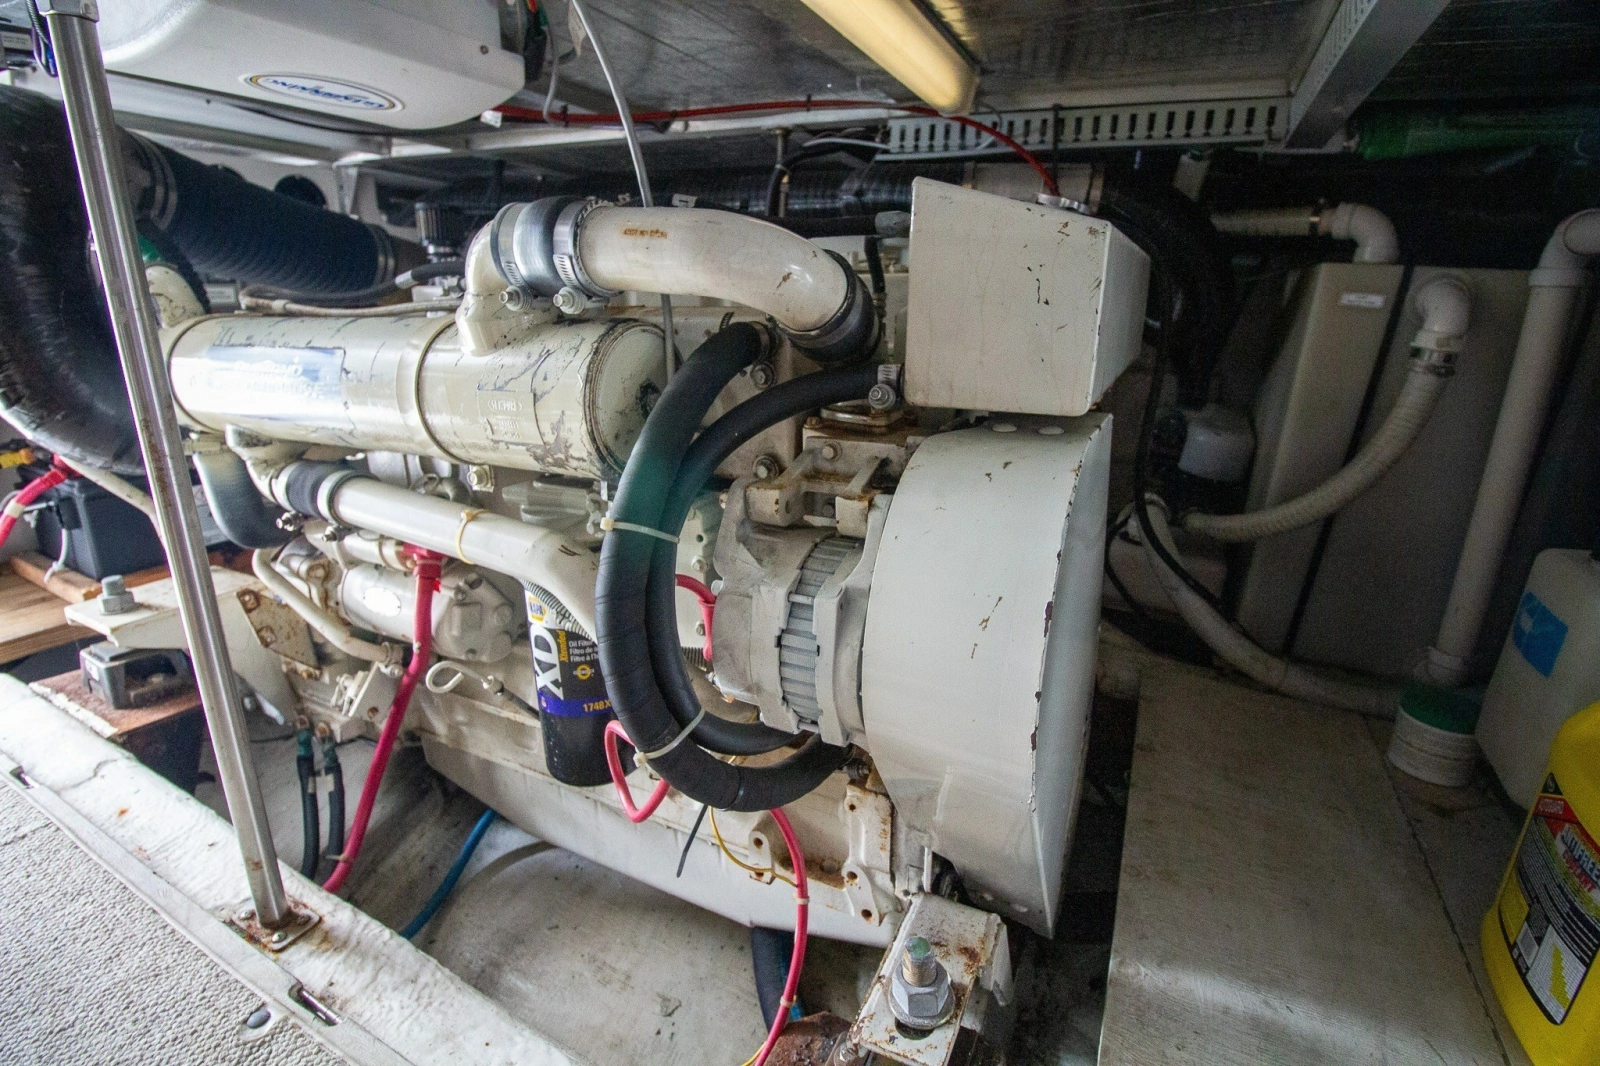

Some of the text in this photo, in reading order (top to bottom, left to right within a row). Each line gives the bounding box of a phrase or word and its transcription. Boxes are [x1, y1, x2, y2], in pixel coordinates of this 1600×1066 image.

[529, 602, 544, 616] NAPA
[530, 622, 564, 700] XD
[1560, 823, 1600, 886] ANTIFREE
